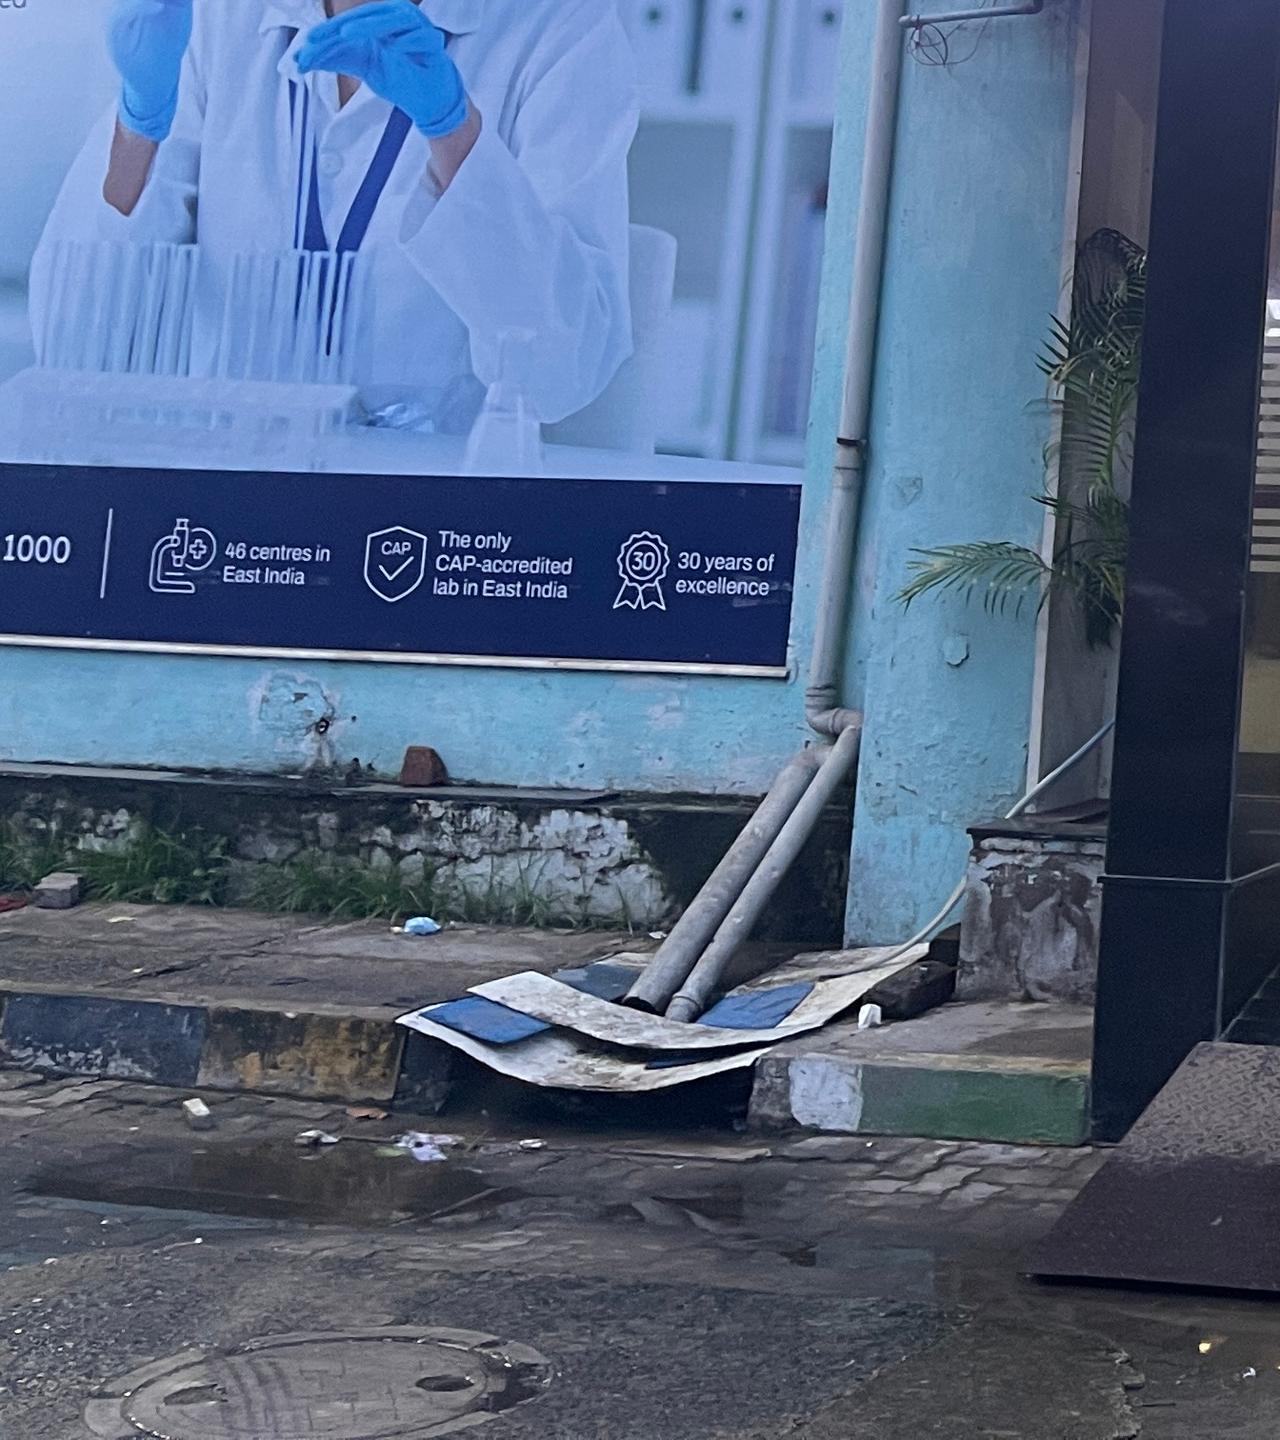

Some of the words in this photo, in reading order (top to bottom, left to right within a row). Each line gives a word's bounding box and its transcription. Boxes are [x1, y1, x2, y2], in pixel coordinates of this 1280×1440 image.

[3, 534, 71, 564] 1000
[381, 540, 412, 555] CAP
[439, 530, 472, 548] The
[475, 532, 512, 552] only
[225, 543, 246, 560] 46
[250, 545, 312, 562] centres
[316, 546, 331, 563] in
[631, 551, 656, 570] 30
[677, 552, 701, 570] 30
[704, 555, 752, 574] years
[757, 553, 775, 573] of
[435, 554, 573, 575] CAP-accredited
[222, 566, 261, 585] East
[264, 568, 305, 586] India
[433, 578, 460, 596] lab
[464, 578, 479, 596] in
[483, 579, 522, 598] East
[526, 579, 568, 599] India
[675, 578, 770, 597] excellence
